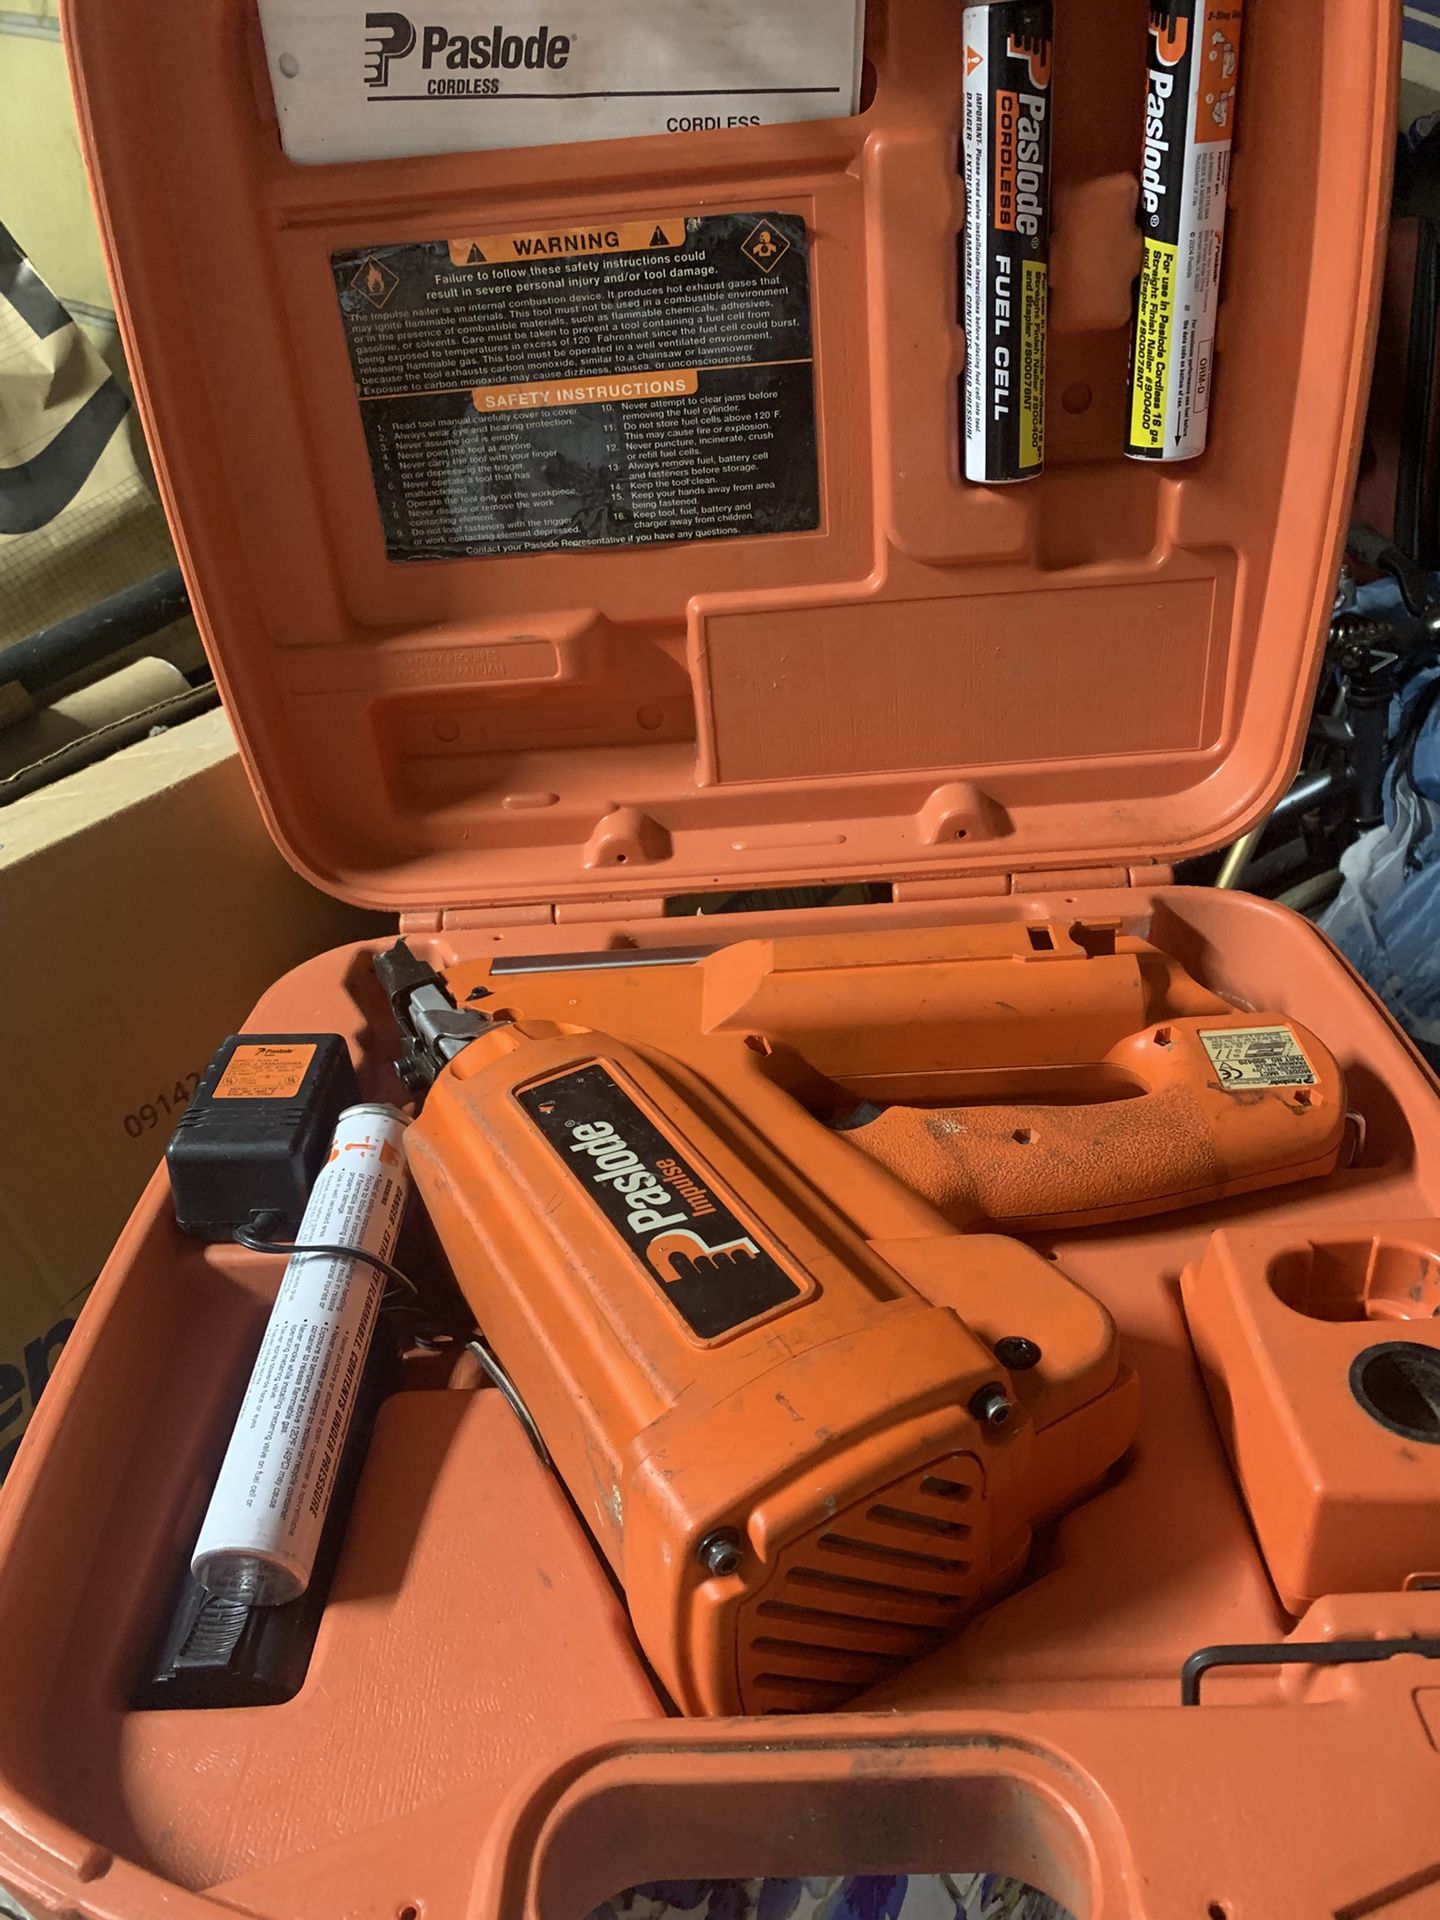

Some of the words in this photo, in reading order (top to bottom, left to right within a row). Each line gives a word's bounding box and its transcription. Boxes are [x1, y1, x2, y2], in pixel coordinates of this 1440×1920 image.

[422, 26, 571, 69] Paslode
[427, 78, 500, 95] CORDLESS
[1142, 70, 1174, 213] Paslode
[1001, 96, 1012, 225] CORDLESS
[1016, 93, 1046, 236] Paslode
[513, 231, 619, 256] WARNING
[434, 271, 474, 284] Failure
[476, 270, 489, 280] to
[492, 266, 527, 279] follow
[530, 263, 561, 275] these
[564, 260, 599, 275] safety
[602, 253, 670, 269] instructions
[674, 250, 705, 262] could
[1149, 250, 1161, 299] Straight
[1163, 253, 1173, 274] For
[425, 288, 458, 299] result
[461, 286, 472, 296] in
[476, 285, 512, 295] severe
[515, 278, 565, 294] personal
[567, 275, 600, 289] injury
[603, 271, 640, 283] and/or
[644, 269, 665, 280] tool
[669, 264, 718, 280] damage.
[994, 255, 1010, 336] FUEL
[1033, 271, 1042, 319] Straight
[1140, 272, 1150, 315] Stapler
[1161, 277, 1170, 298] use
[1024, 295, 1033, 337] Stapler
[1148, 303, 1158, 335] Finish
[1161, 301, 1171, 311] in
[1033, 322, 1041, 350] Finish
[1157, 315, 1168, 358] Paslode
[974, 343, 982, 369] placing
[1136, 319, 1148, 391] #900078NT
[1146, 339, 1156, 372] Nailer
[994, 346, 1010, 420] CELL
[1033, 358, 1041, 391] Nailer
[1153, 362, 1165, 409] Cordless
[1197, 358, 1207, 394] ORM-D
[485, 390, 550, 406] SAFETY
[556, 379, 686, 401] INSTRUCTIONS
[601, 403, 614, 411] 10.
[621, 401, 648, 410] Never
[650, 398, 685, 409] attempt
[699, 395, 721, 403] clear
[724, 393, 746, 403] jams
[748, 390, 777, 399] before
[1142, 376, 1153, 430] #900400
[603, 423, 616, 431] 11.
[623, 422, 636, 430] Do
[639, 420, 654, 428] not
[656, 418, 678, 427] store
[681, 417, 697, 425] fuel
[700, 415, 721, 423] cells
[723, 412, 751, 422] above
[622, 410, 664, 422] removing
[666, 408, 681, 416] the
[683, 407, 699, 415] fuel
[702, 403, 740, 415] cylinder.
[625, 432, 643, 440] This
[645, 431, 665, 440] may
[696, 426, 710, 434] fire
[724, 421, 771, 434] explosion.
[625, 441, 652, 450] Never
[654, 438, 697, 449] puncture,
[699, 434, 746, 445] incinerate,
[748, 432, 773, 440] crush
[1149, 429, 1159, 446] ga.
[627, 461, 659, 471] Always
[661, 459, 694, 467] remove
[696, 456, 715, 465] fuel,
[718, 453, 750, 464] battery
[752, 452, 768, 460] cell
[638, 451, 657, 459] refill
[659, 449, 676, 457] fuel
[678, 447, 701, 456] cells.
[610, 483, 623, 491] 14.
[630, 481, 653, 491] Keep
[671, 478, 689, 486] tool
[691, 476, 717, 484] clean.
[628, 472, 645, 480] and
[648, 468, 689, 478] fasteners
[691, 466, 719, 475] before
[722, 462, 758, 474] storage.
[631, 491, 654, 501] Keep
[656, 490, 675, 499] your
[677, 487, 705, 495] hands
[707, 486, 731, 495] away
[732, 483, 753, 491] from
[632, 500, 656, 510] being
[658, 497, 699, 507] fastened.
[613, 512, 626, 520] 16.
[633, 510, 656, 520] Keep
[658, 508, 677, 517] tool,
[680, 506, 698, 515] fuel,
[701, 504, 732, 515] battery
[734, 502, 751, 510] and
[633, 519, 667, 529] charger
[669, 518, 692, 526] away
[694, 515, 714, 523] from
[569, 1120, 688, 1234] Paslode
[656, 1157, 716, 1218] Impulse
[353, 1284, 377, 1350] FLAMMABLE.
[337, 1351, 357, 1412] CONTENTS
[326, 1409, 342, 1454] UNDER
[309, 1452, 332, 1519] PRESSURE
